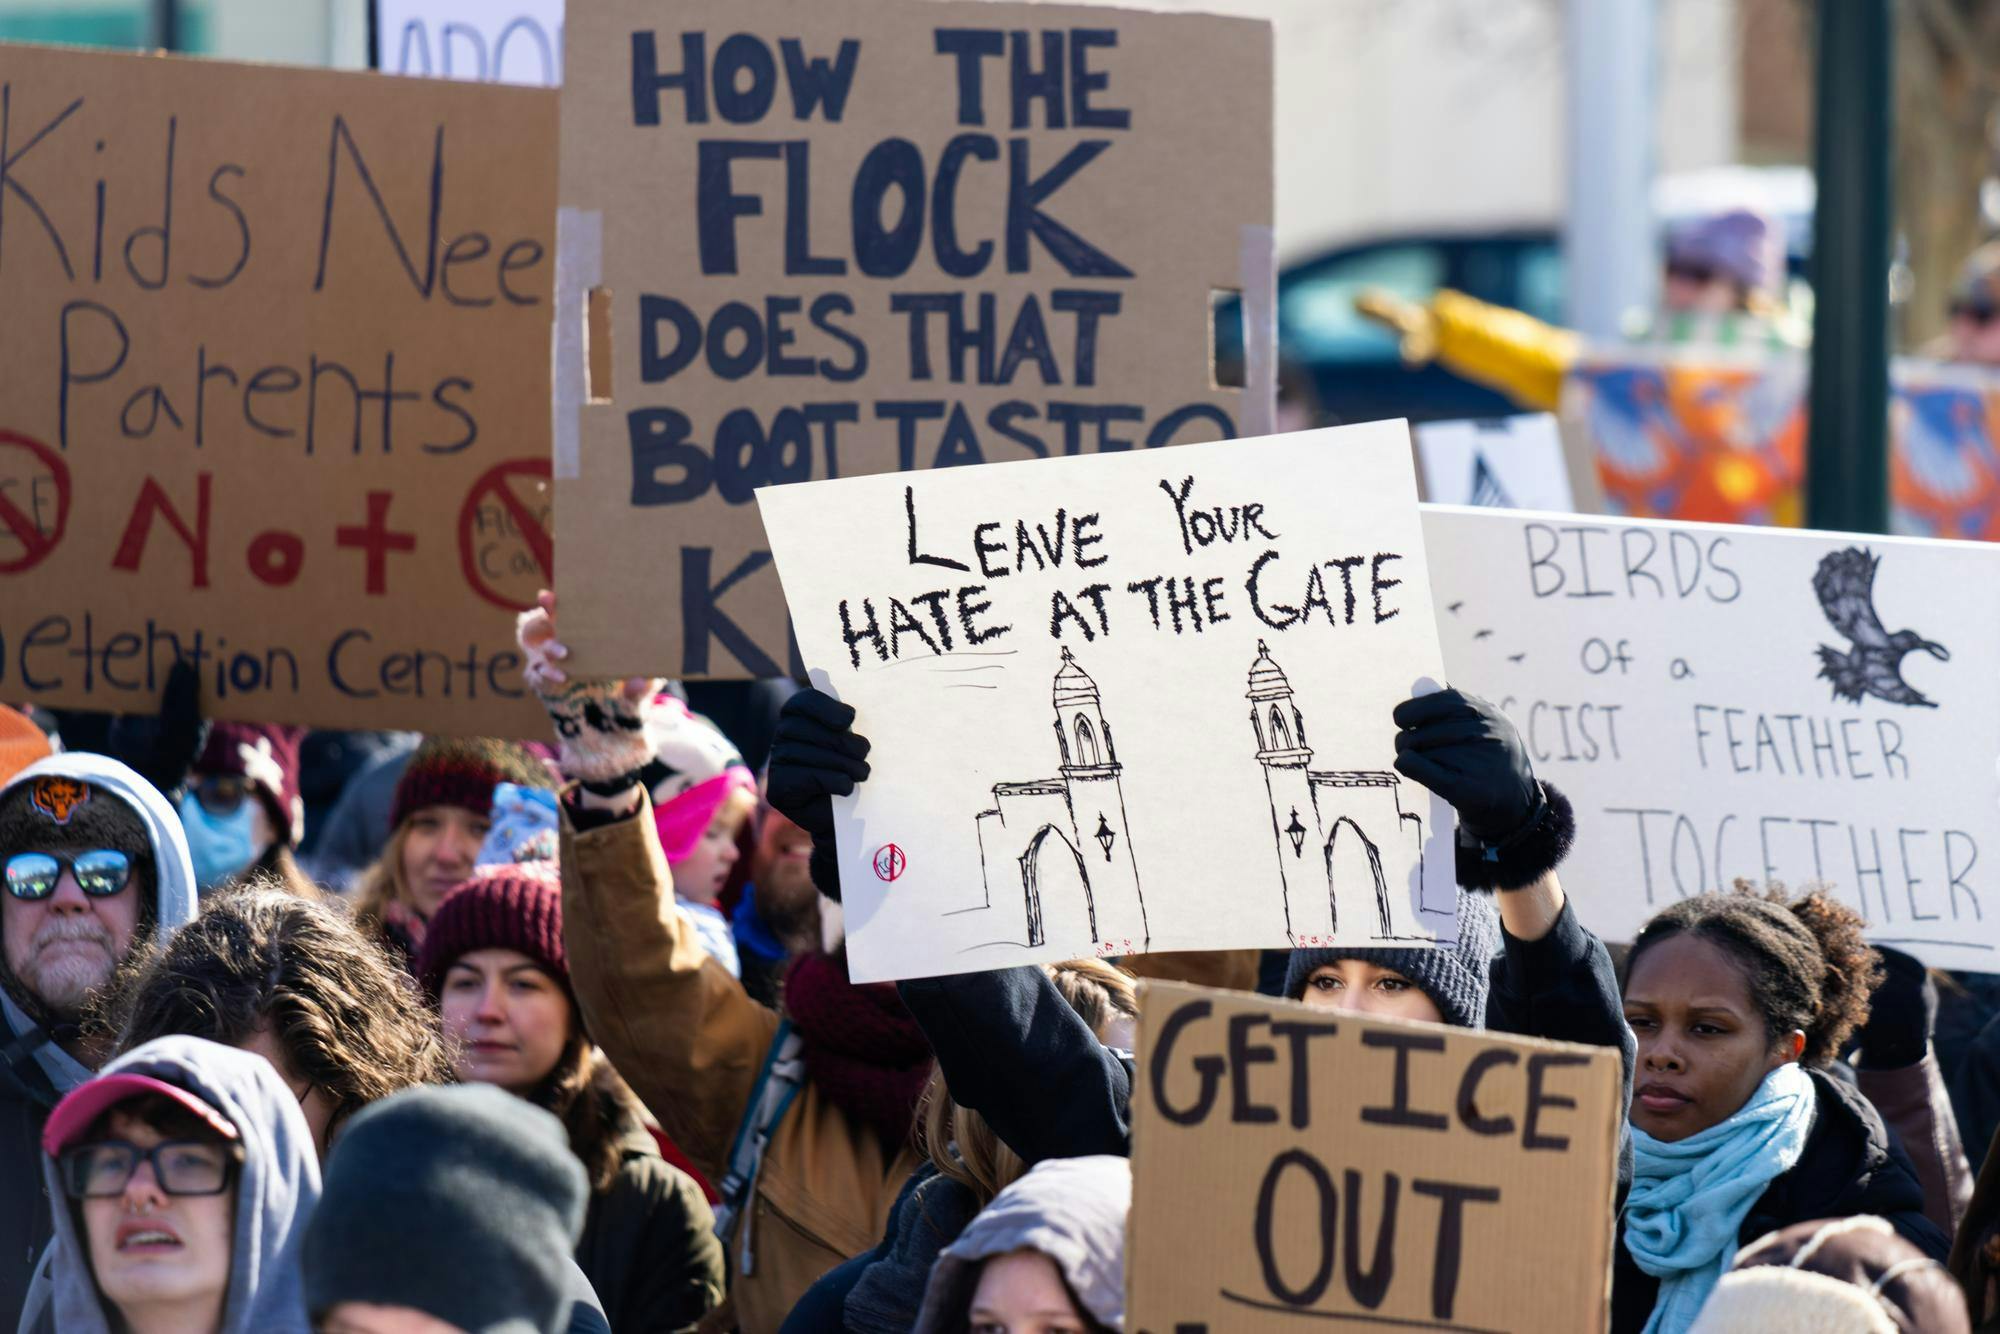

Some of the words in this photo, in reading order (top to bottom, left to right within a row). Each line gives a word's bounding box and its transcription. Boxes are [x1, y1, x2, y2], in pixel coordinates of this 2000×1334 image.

[630, 30, 860, 126] HOW
[934, 28, 1131, 130] THE
[0, 82, 250, 289] Kids
[314, 115, 544, 306] Nee
[698, 134, 1136, 278] FLOCK
[59, 300, 477, 454] Parents
[639, 293, 868, 384] DOES
[891, 289, 1122, 387] THAT
[628, 402, 859, 506] BOOT
[112, 471, 416, 595] Not
[905, 485, 1108, 578] LEAVE
[1160, 475, 1281, 555] YOUR
[1524, 523, 1741, 604] BIRDS
[0, 611, 299, 696] etention
[328, 628, 524, 698] Cente
[838, 584, 1012, 671] HATE
[1050, 582, 1111, 642] AT
[1127, 574, 1230, 634] THE
[1245, 549, 1403, 631] GATE
[1669, 656, 1694, 679] a
[1500, 696, 1622, 764] CIST
[1693, 704, 1909, 780] FEATHER
[1149, 999, 1338, 1130] GET
[1360, 1030, 1591, 1151] ICE
[1254, 1147, 1501, 1320] OUT
